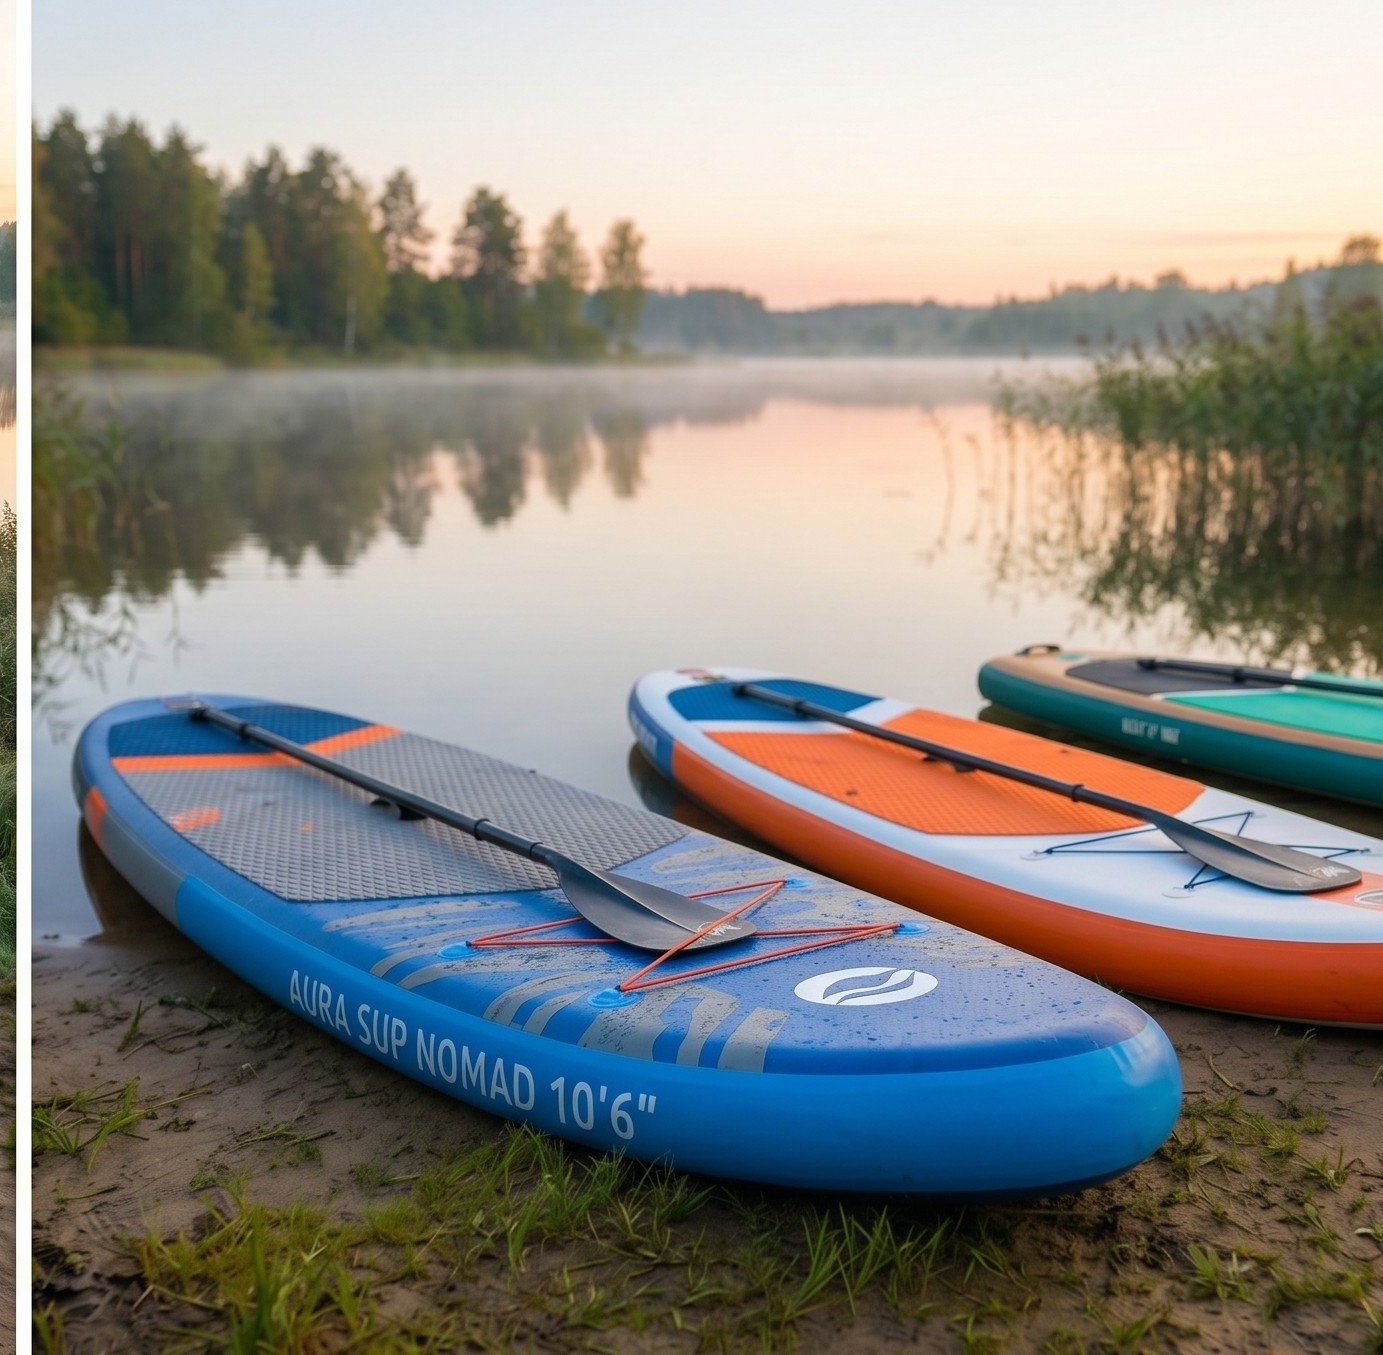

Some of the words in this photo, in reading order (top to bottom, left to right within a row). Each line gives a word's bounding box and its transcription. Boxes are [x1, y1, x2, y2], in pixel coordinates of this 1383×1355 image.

[289, 969, 352, 1037] AURA
[357, 1003, 407, 1060] SUP
[416, 1028, 535, 1111] NOMAD
[550, 1076, 657, 1140] 10'6"
